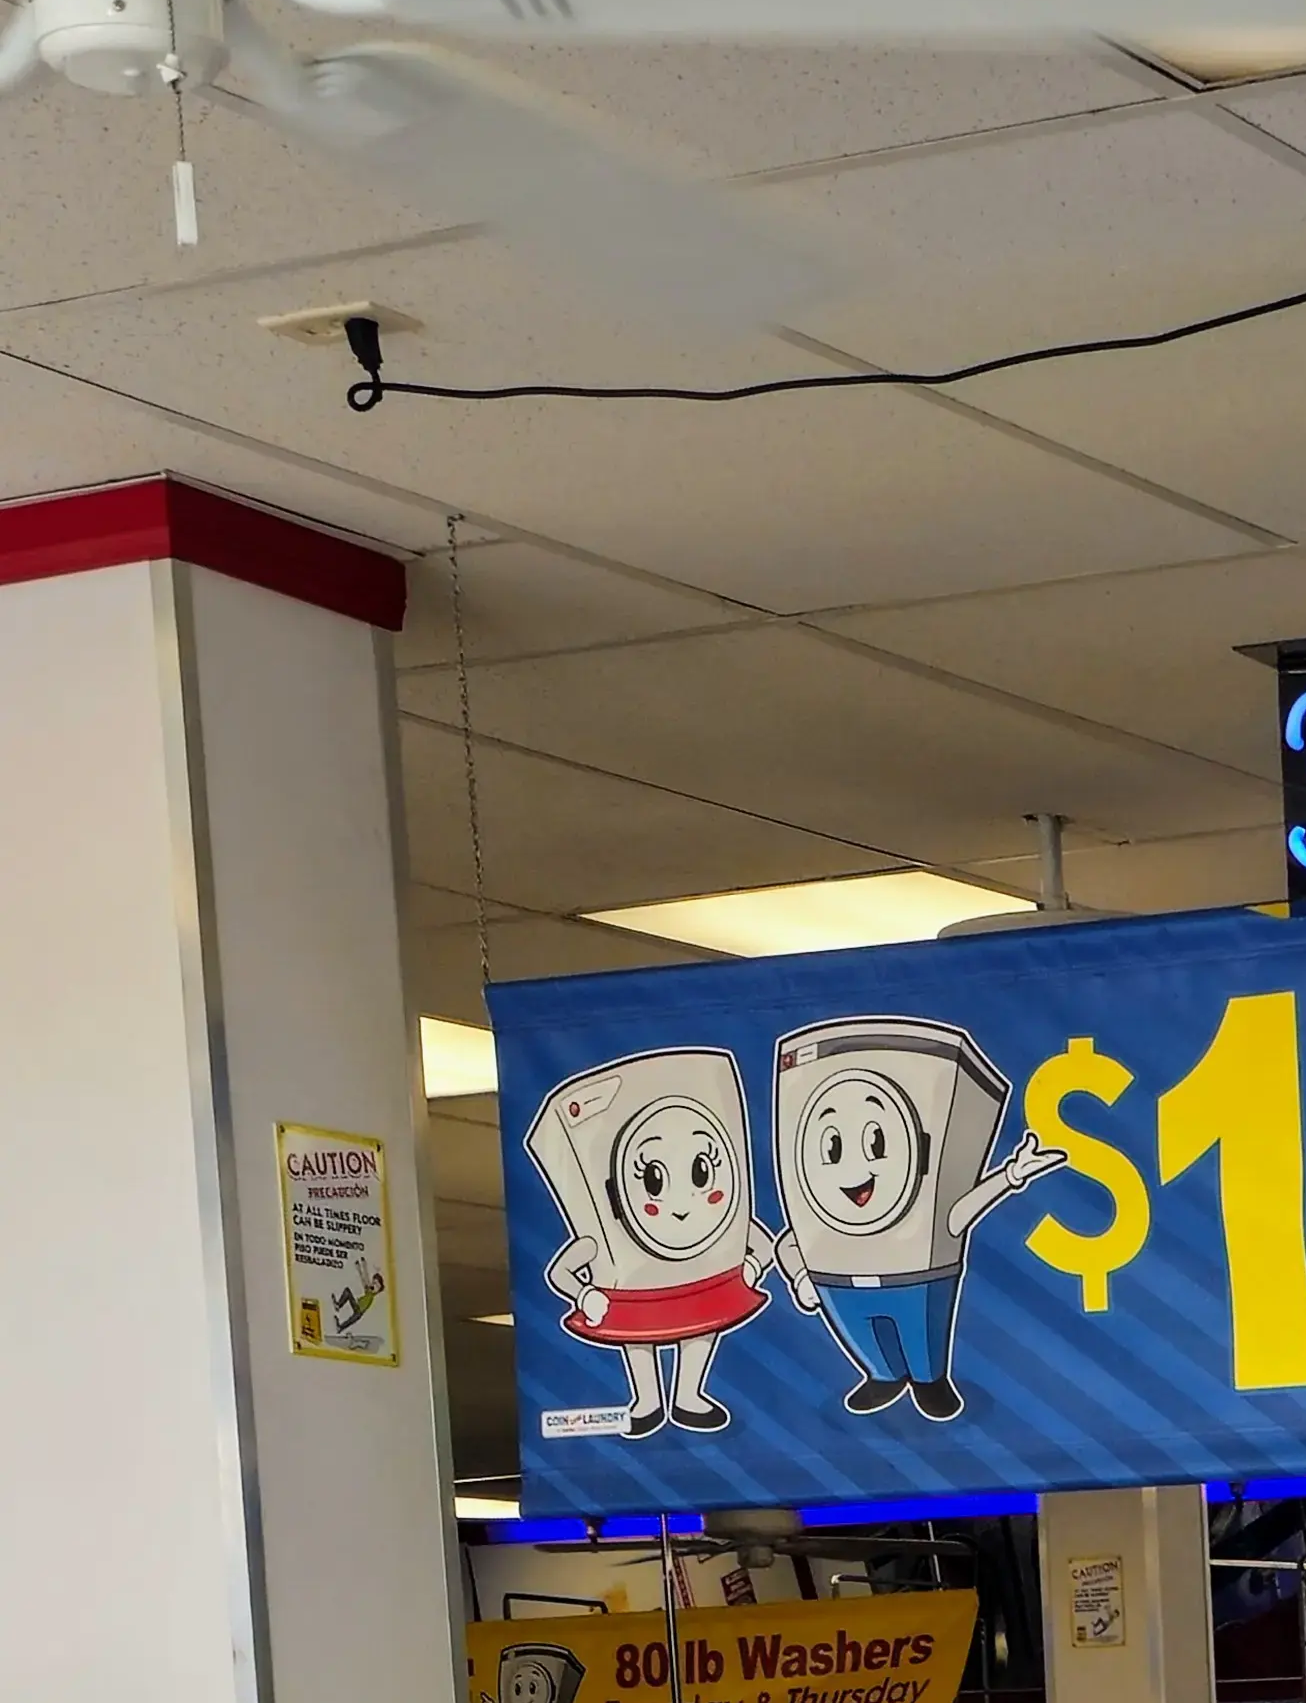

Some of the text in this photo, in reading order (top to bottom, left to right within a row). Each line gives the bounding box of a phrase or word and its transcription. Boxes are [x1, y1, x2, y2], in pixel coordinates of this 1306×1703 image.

[287, 1151, 377, 1177] CAUTION
[293, 1215, 362, 1236] CAN BE SLIPPERY
[306, 1205, 322, 1216] ALL
[325, 1207, 350, 1221] TIMES
[353, 1212, 381, 1227] FLOOR
[615, 1630, 935, 1688] 80 lb Washers
